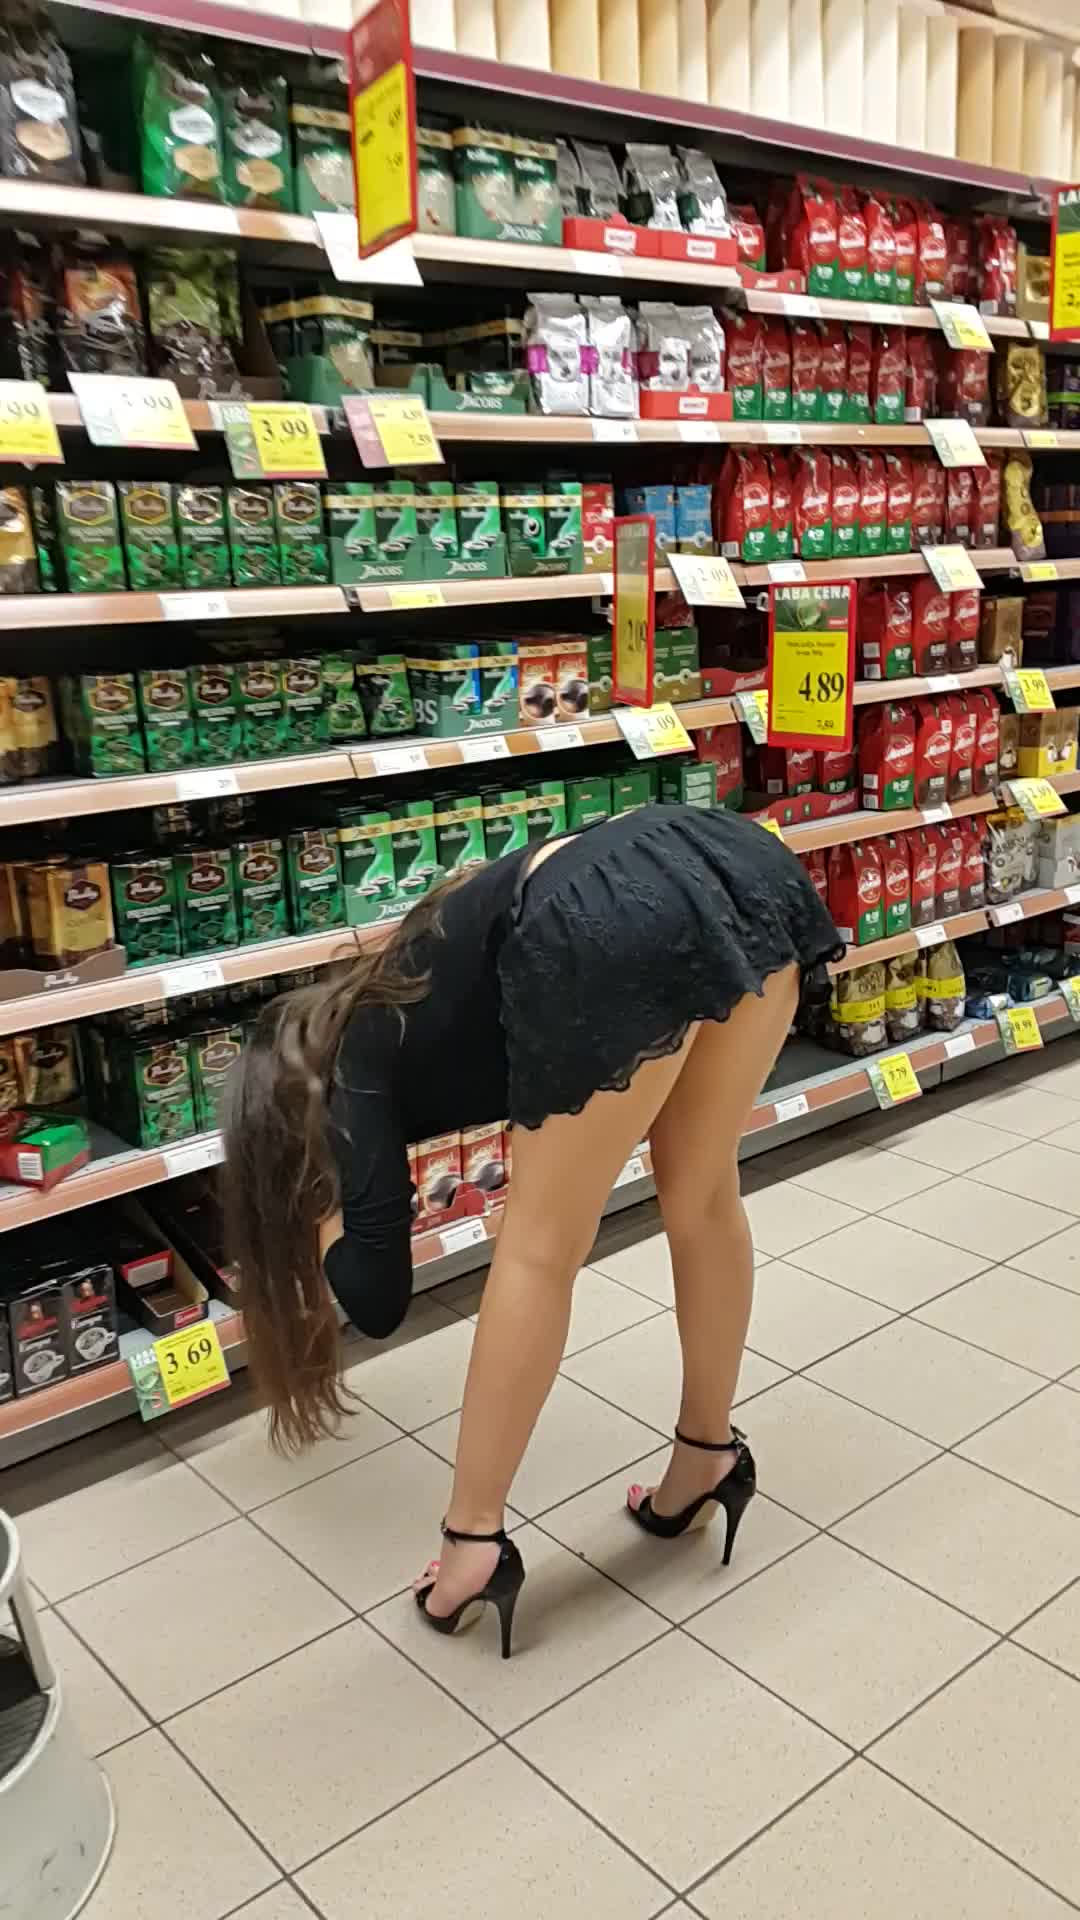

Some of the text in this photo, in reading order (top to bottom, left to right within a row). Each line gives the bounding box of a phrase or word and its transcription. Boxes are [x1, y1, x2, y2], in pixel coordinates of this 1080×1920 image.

[360, 564, 404, 580] JACOBS
[446, 560, 488, 576] JACOBS
[799, 671, 845, 705] 4,89
[465, 718, 504, 732] JACOBS
[165, 1337, 212, 1375] 3.69
